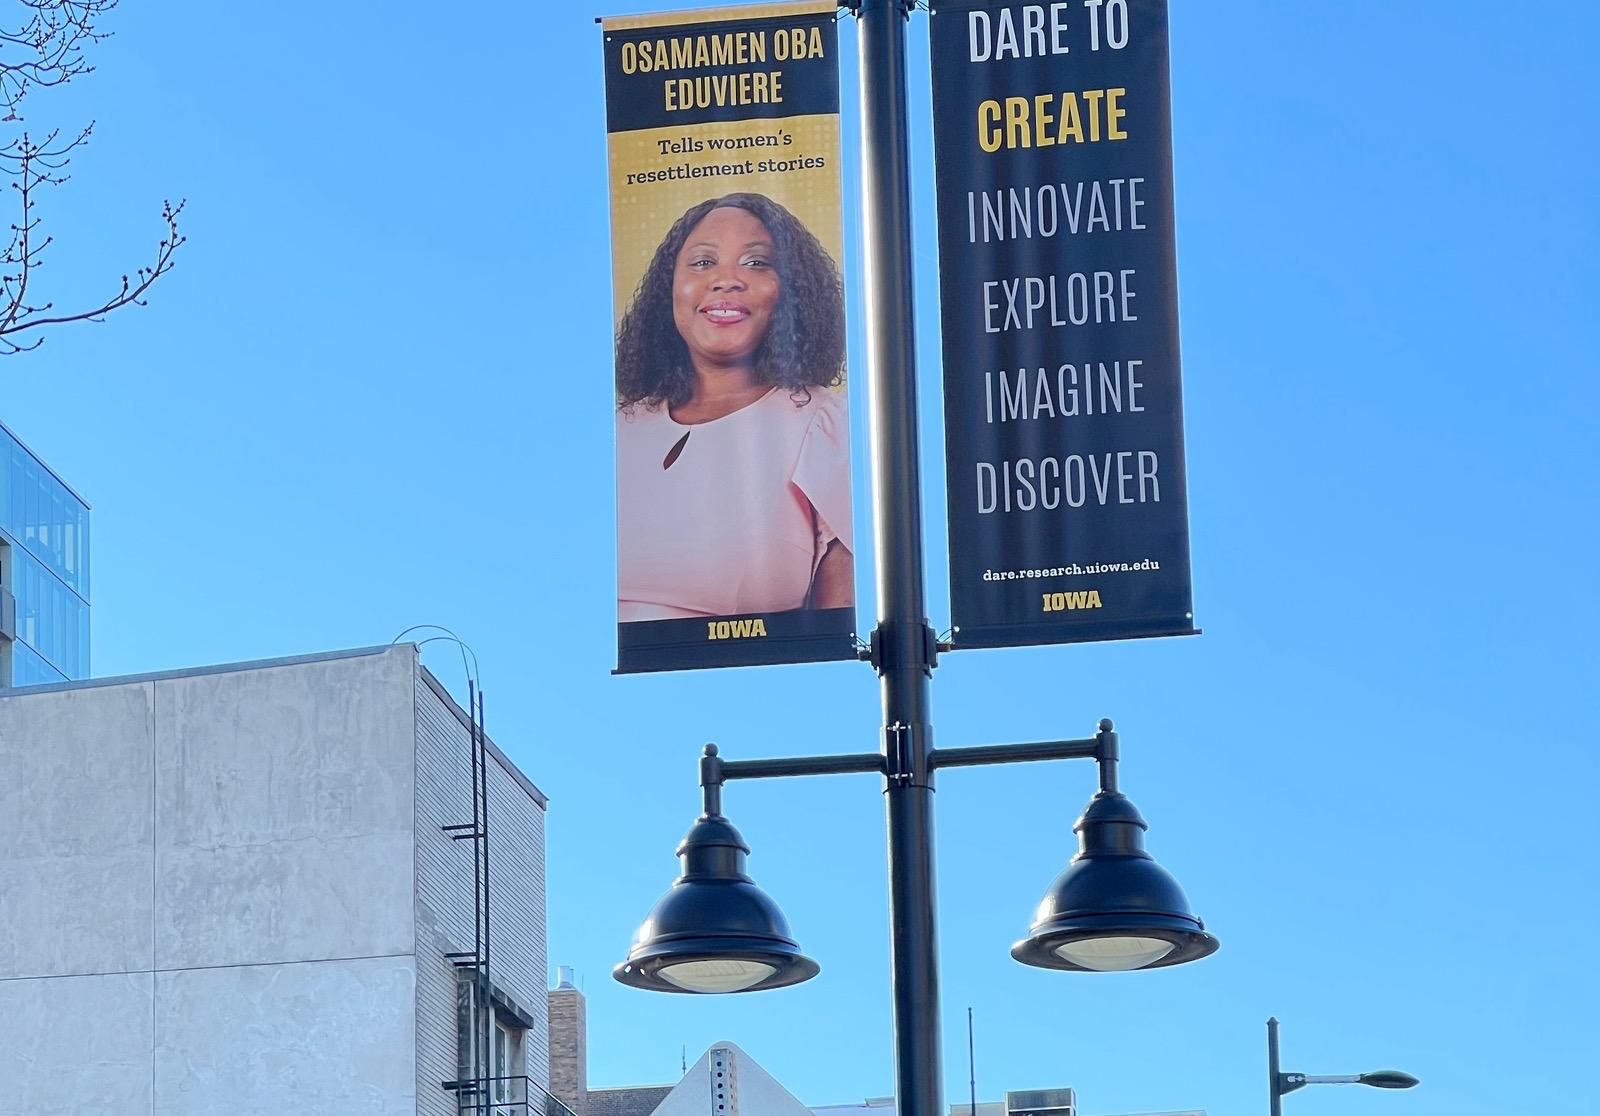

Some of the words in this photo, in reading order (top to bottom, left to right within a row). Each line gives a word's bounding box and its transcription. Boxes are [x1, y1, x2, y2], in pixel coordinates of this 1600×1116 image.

[621, 31, 766, 75] OSAMAMEN
[774, 27, 824, 61] OBA
[968, 2, 1069, 63] DARE
[1084, 0, 1129, 51] TO
[664, 71, 783, 112] EDUVIERE
[657, 137, 704, 155] Tells
[707, 129, 793, 150] women's
[977, 88, 1128, 153] CREATE
[626, 160, 754, 185] resettlement
[757, 154, 825, 173] stories
[967, 177, 1146, 243] INNOVATE
[983, 269, 1138, 333] EXPLORE
[985, 360, 1145, 424] IMAGINE
[976, 450, 1160, 514] DISCOVER
[982, 558, 1160, 581] dare.research.uiowa.edu
[1042, 590, 1102, 612] IOWA
[707, 618, 767, 640] IOWA
